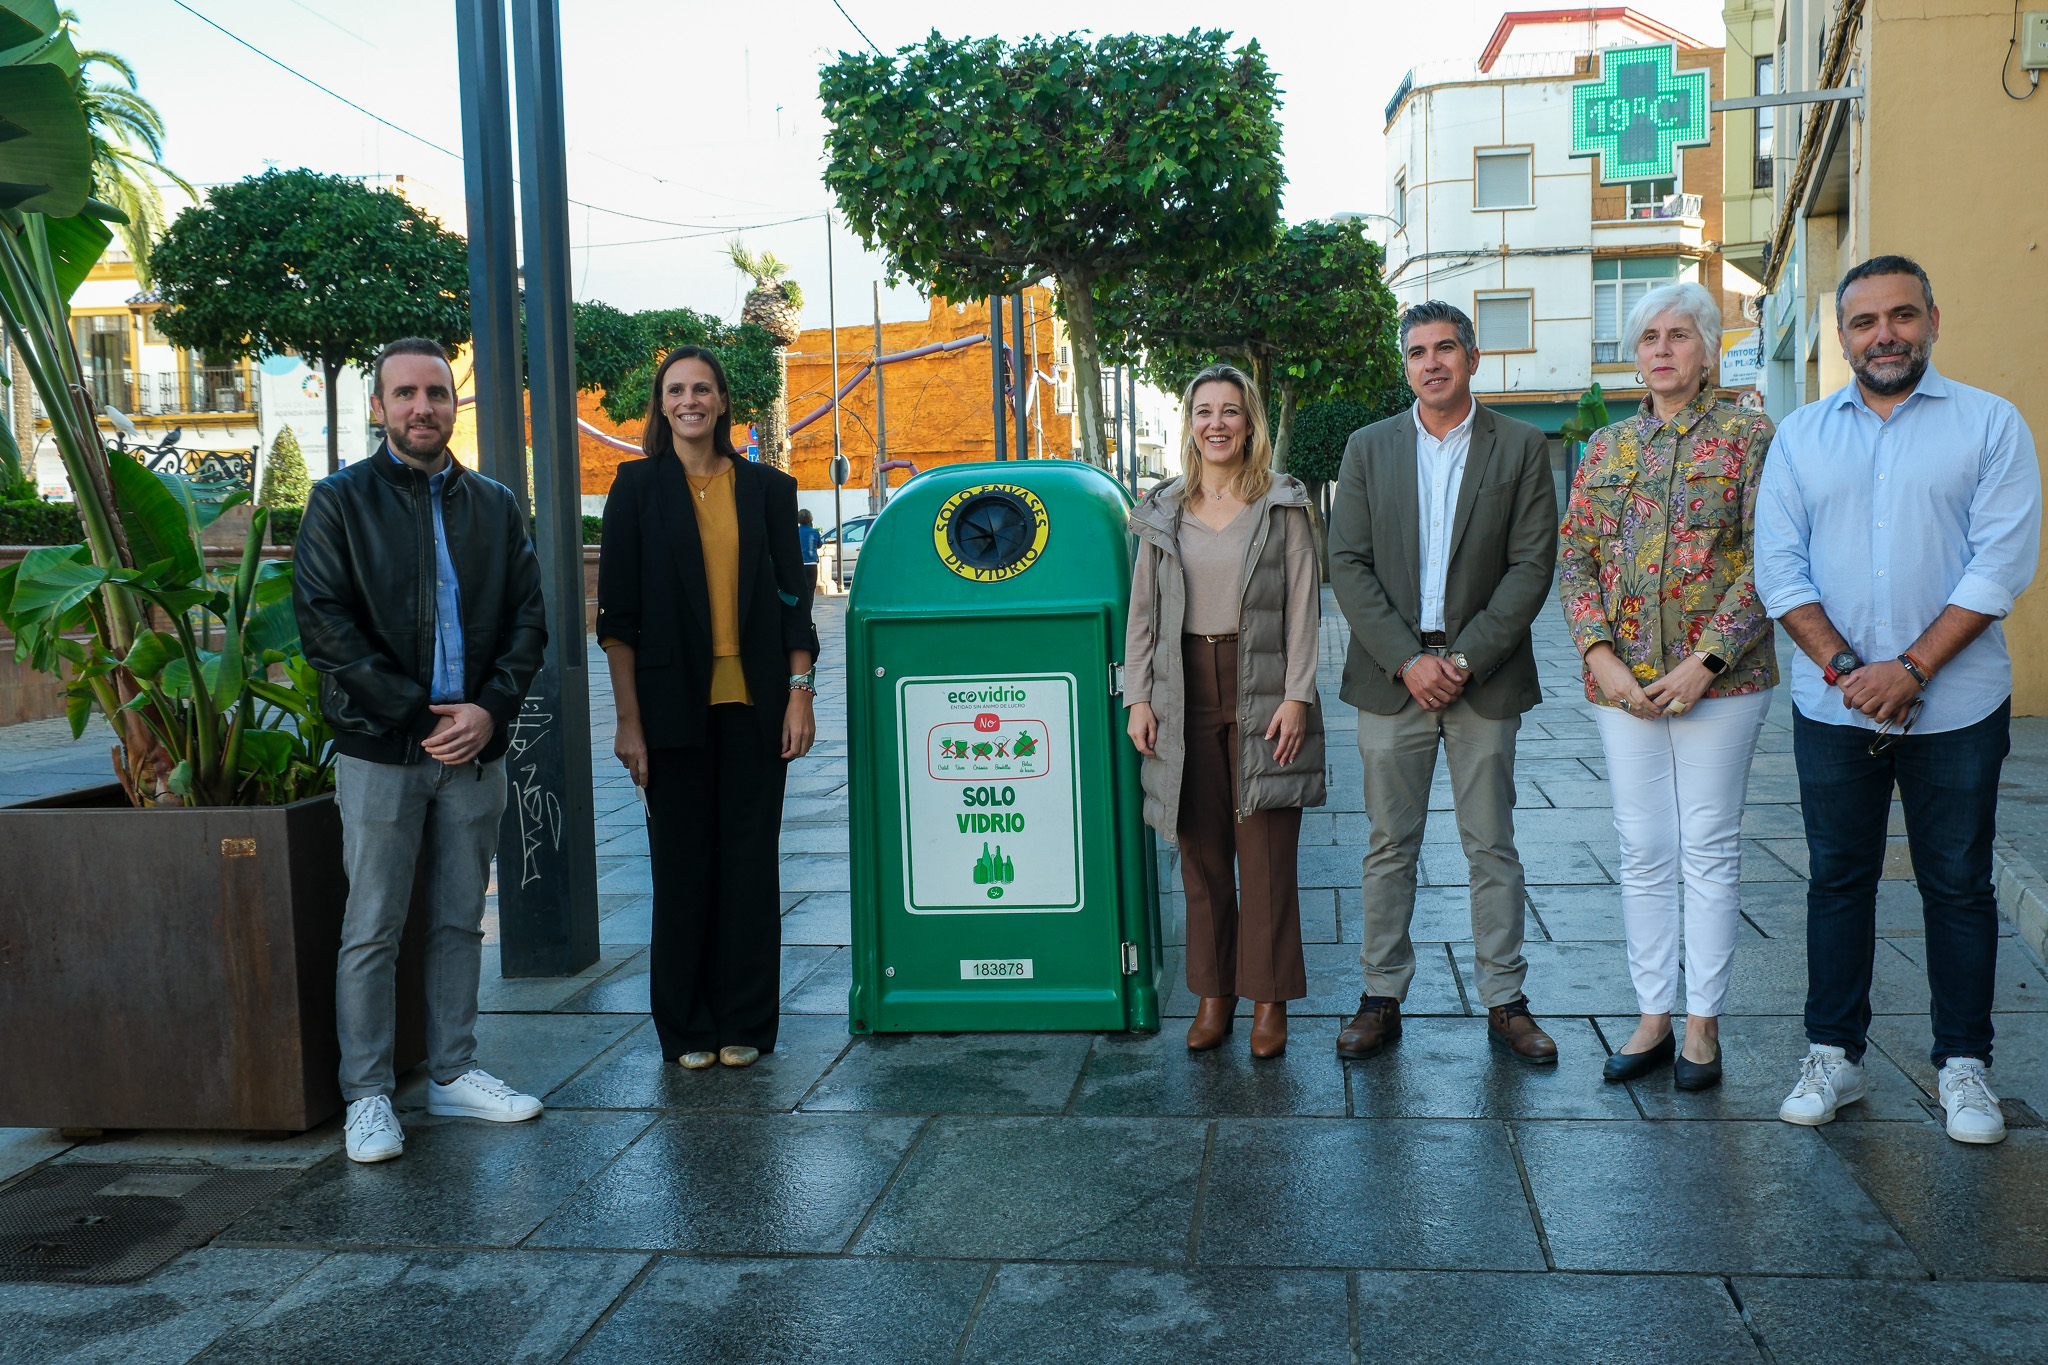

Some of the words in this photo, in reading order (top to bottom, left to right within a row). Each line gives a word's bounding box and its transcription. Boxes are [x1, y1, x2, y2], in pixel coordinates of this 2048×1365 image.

[982, 484, 1047, 529] ENVASES
[944, 553, 966, 574] DE
[973, 547, 1039, 581] VIDRIO
[947, 685, 1027, 704] ecovidrio
[979, 717, 997, 729] No
[962, 786, 1016, 807] SOLO
[956, 812, 1026, 834] VIDRIO
[973, 963, 1024, 976] 183878
